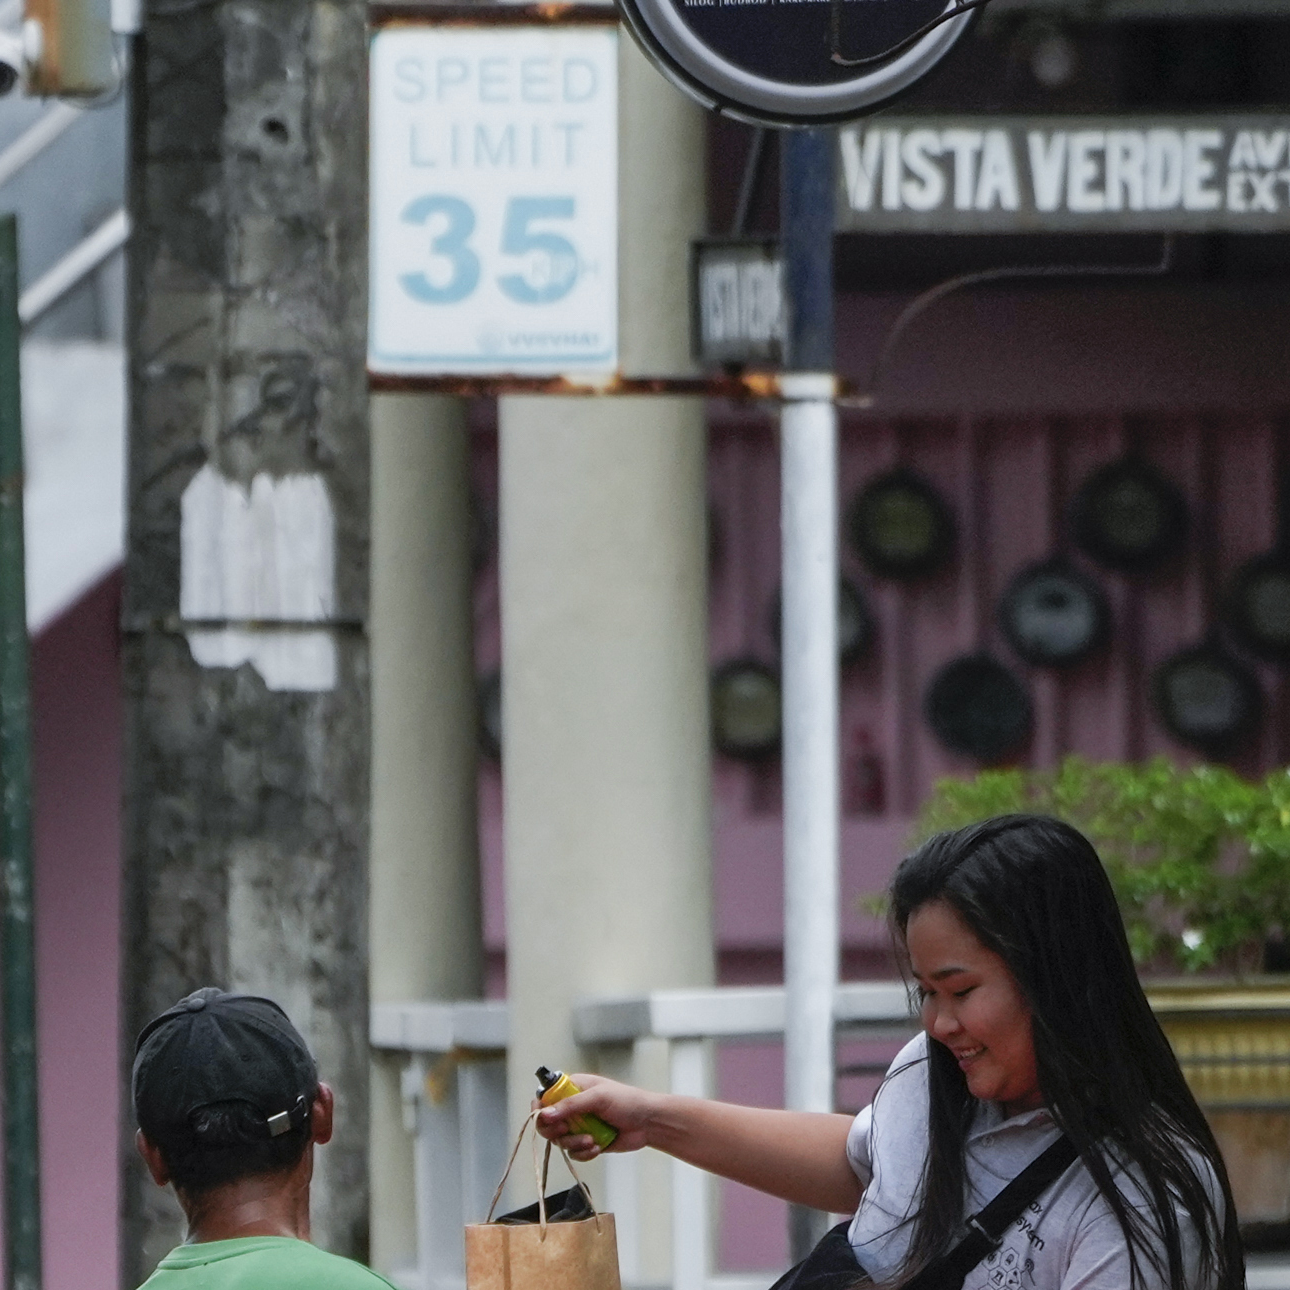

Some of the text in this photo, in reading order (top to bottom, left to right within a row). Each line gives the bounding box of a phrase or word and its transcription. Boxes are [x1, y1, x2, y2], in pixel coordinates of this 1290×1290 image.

[393, 55, 599, 104] SPEED
[409, 121, 585, 169] LIMIT
[840, 129, 1224, 212] VISTA VERDE
[397, 193, 579, 306] 35
